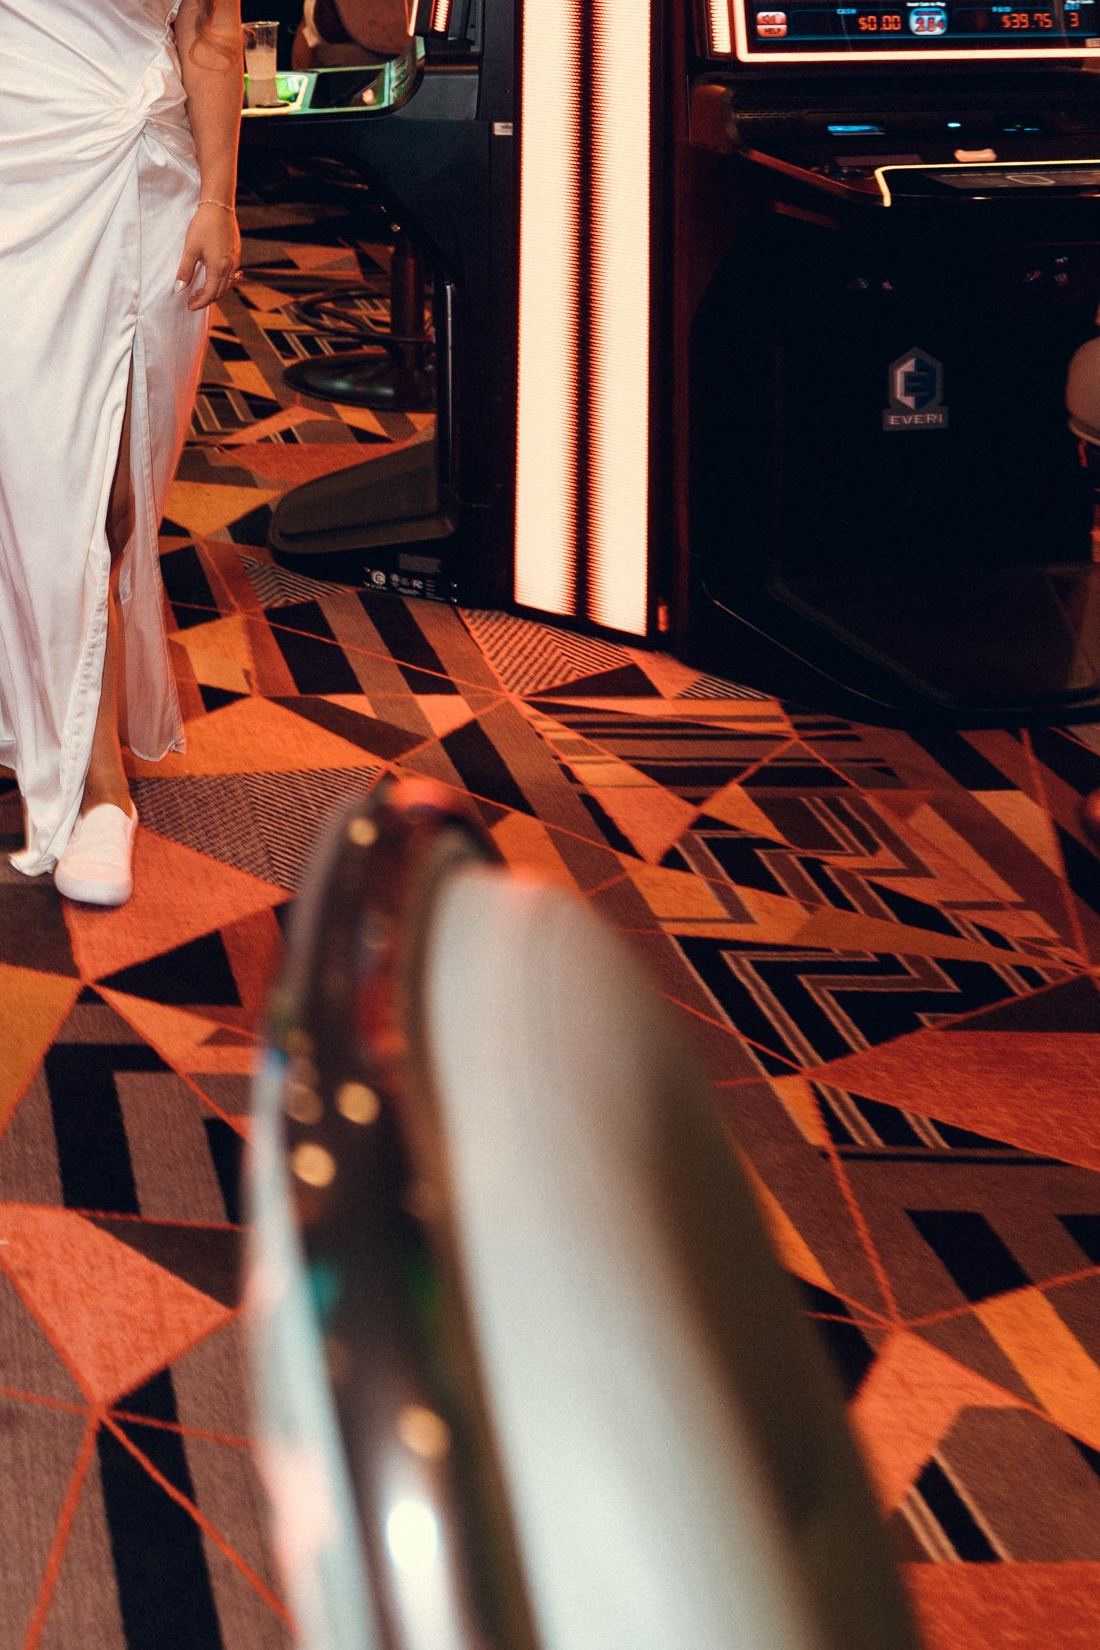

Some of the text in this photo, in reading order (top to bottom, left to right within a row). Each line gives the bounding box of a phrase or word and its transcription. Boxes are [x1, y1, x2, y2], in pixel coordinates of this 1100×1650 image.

[858, 14, 902, 31] $0.00
[915, 17, 945, 32] 25¢
[1001, 12, 1052, 29] $39.75
[1069, 12, 1079, 28] 3
[890, 413, 943, 426] EVERI
